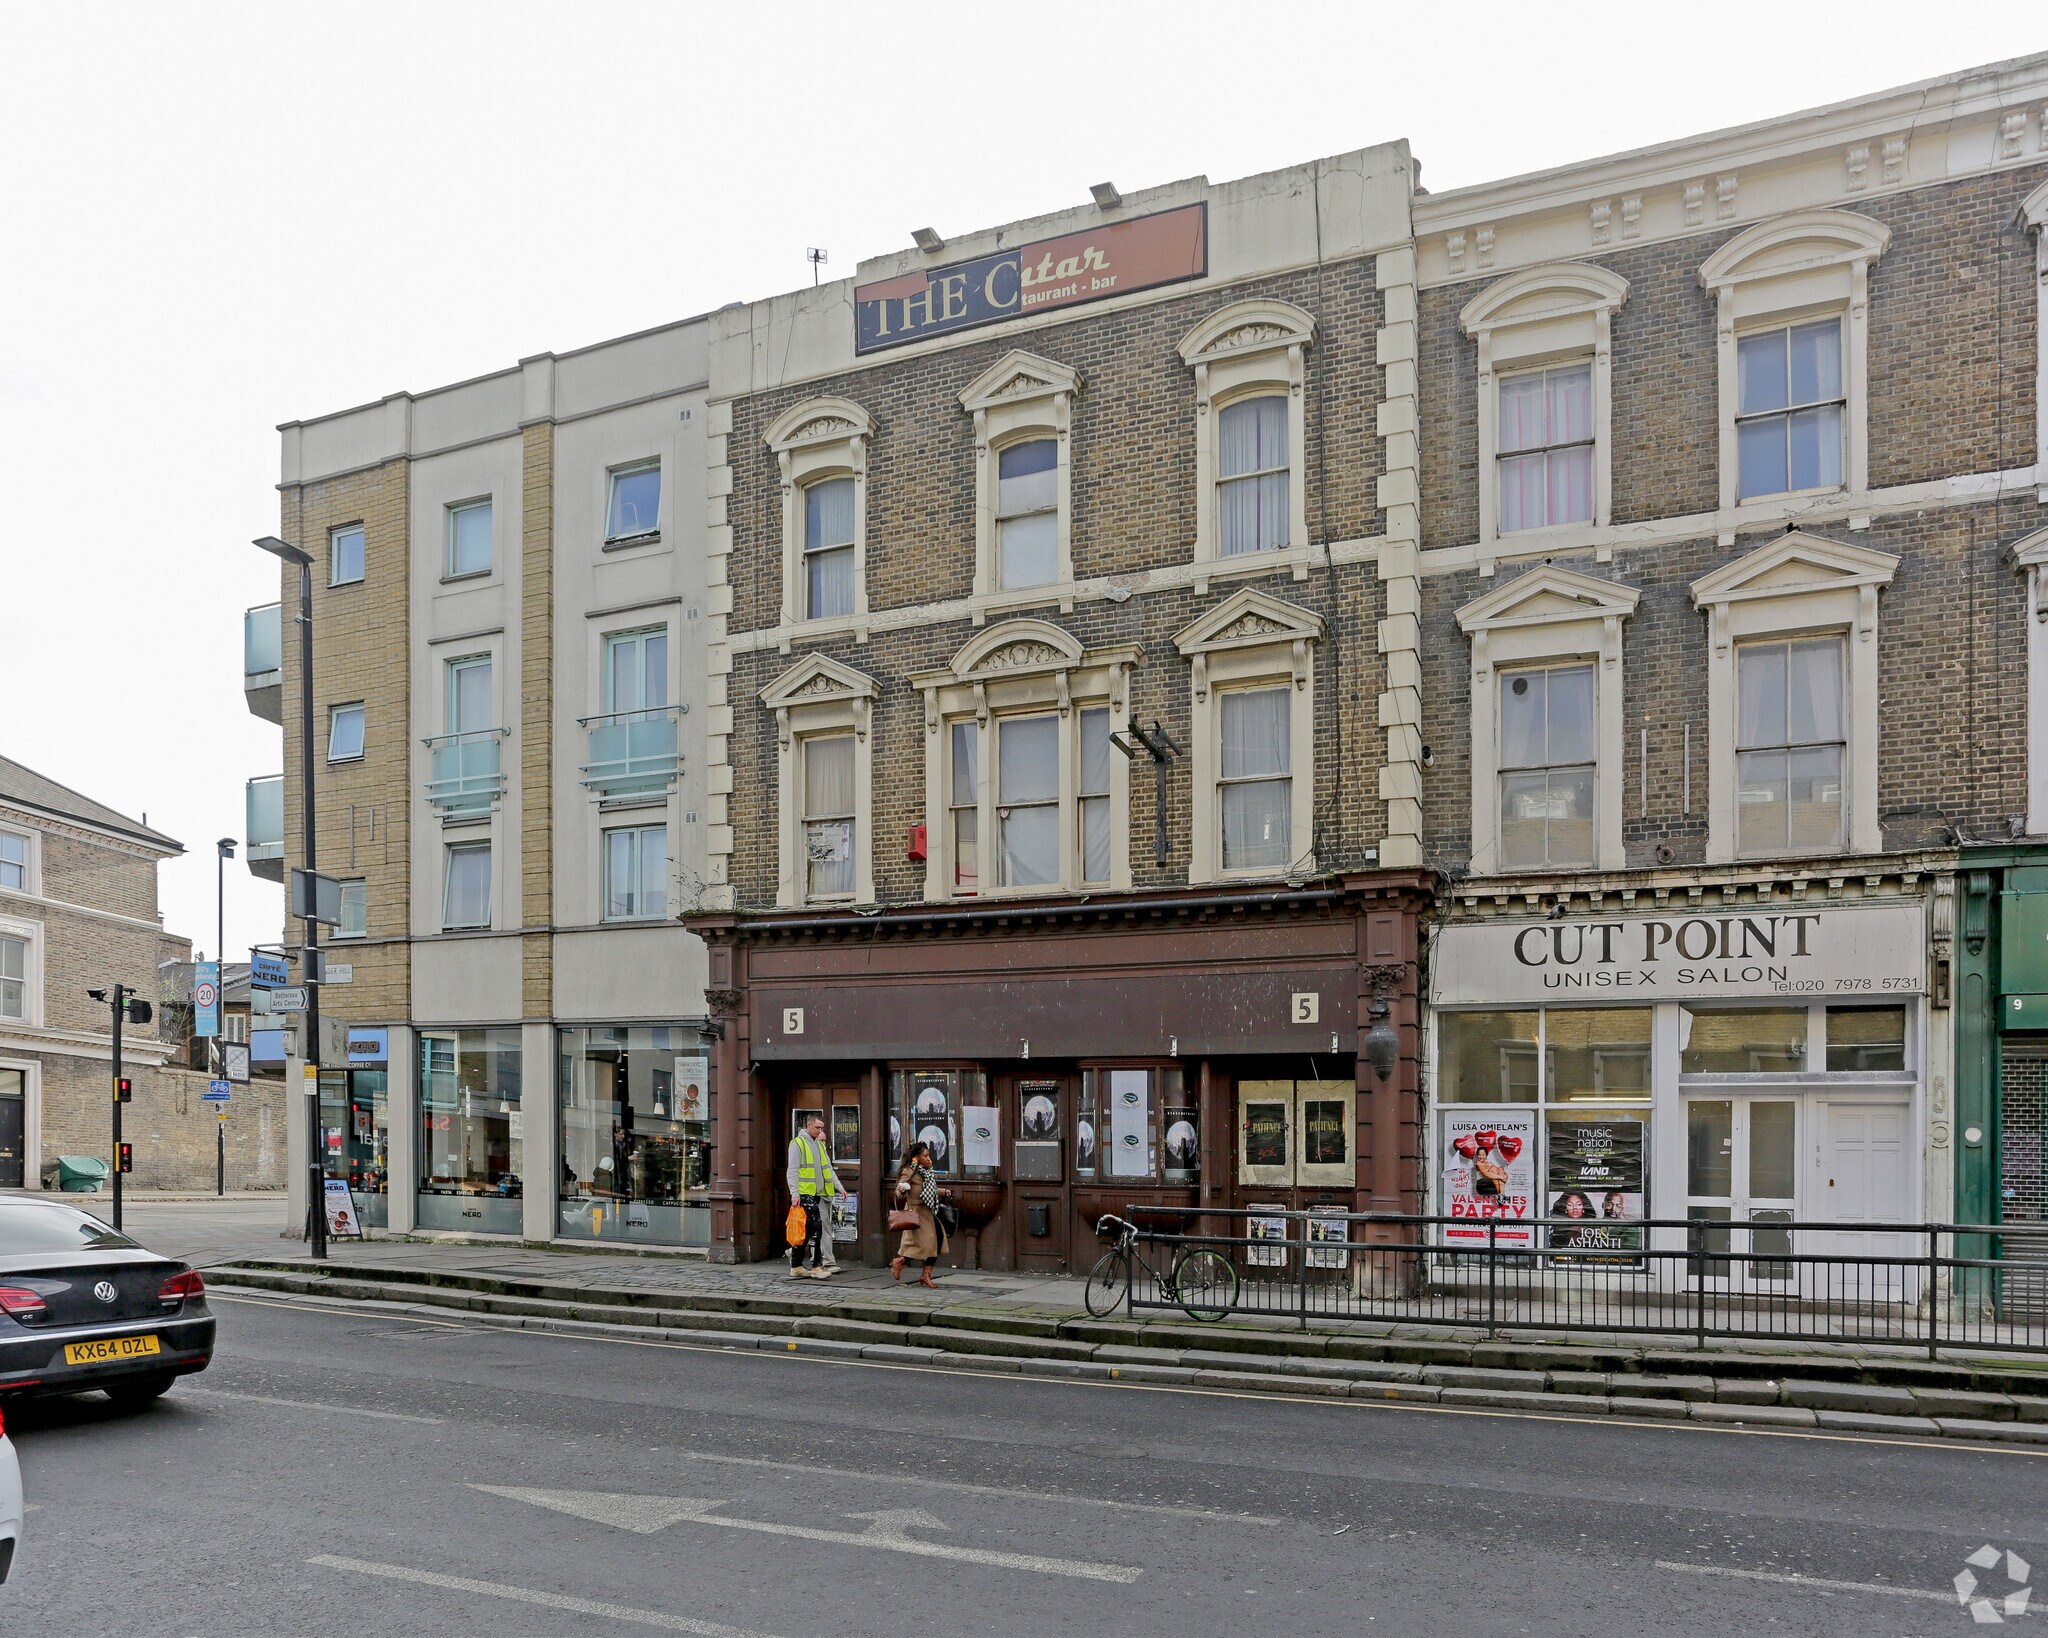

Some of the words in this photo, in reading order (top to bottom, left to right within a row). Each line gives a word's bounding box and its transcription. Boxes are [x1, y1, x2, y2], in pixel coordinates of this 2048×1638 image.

[1091, 274, 1118, 290] bar
[868, 272, 968, 338] THE
[1513, 923, 1624, 966] CUT
[1641, 914, 1821, 962] POINT
[253, 971, 287, 984] NERO
[1543, 970, 1657, 988] UNISEX
[1677, 966, 1787, 984] SALON
[1771, 979, 1824, 992] Tel:020
[1835, 979, 1872, 990] 7978
[1882, 977, 1918, 989] 5731
[200, 990, 212, 1000] 20
[1435, 992, 1442, 1001] 7
[1299, 998, 1311, 1020] 5
[2013, 999, 2022, 1010] 9
[789, 1012, 798, 1031] 5
[1253, 1122, 1281, 1133] PATIENCE
[1309, 1120, 1339, 1131] PATIENCE
[1452, 1123, 1477, 1131] LUISA
[1480, 1123, 1528, 1131] OMIELAN'S
[1578, 1126, 1612, 1138] music
[1578, 1137, 1612, 1148] nation
[1581, 1166, 1609, 1175] KANO
[1452, 1203, 1527, 1219] PARTY
[625, 1220, 648, 1228] NERO
[1581, 1227, 1601, 1239] JOE
[1600, 1227, 1609, 1239] &
[1568, 1237, 1621, 1248] ASHANTI
[73, 1343, 118, 1361] KX64
[121, 1338, 153, 1355] OZL
